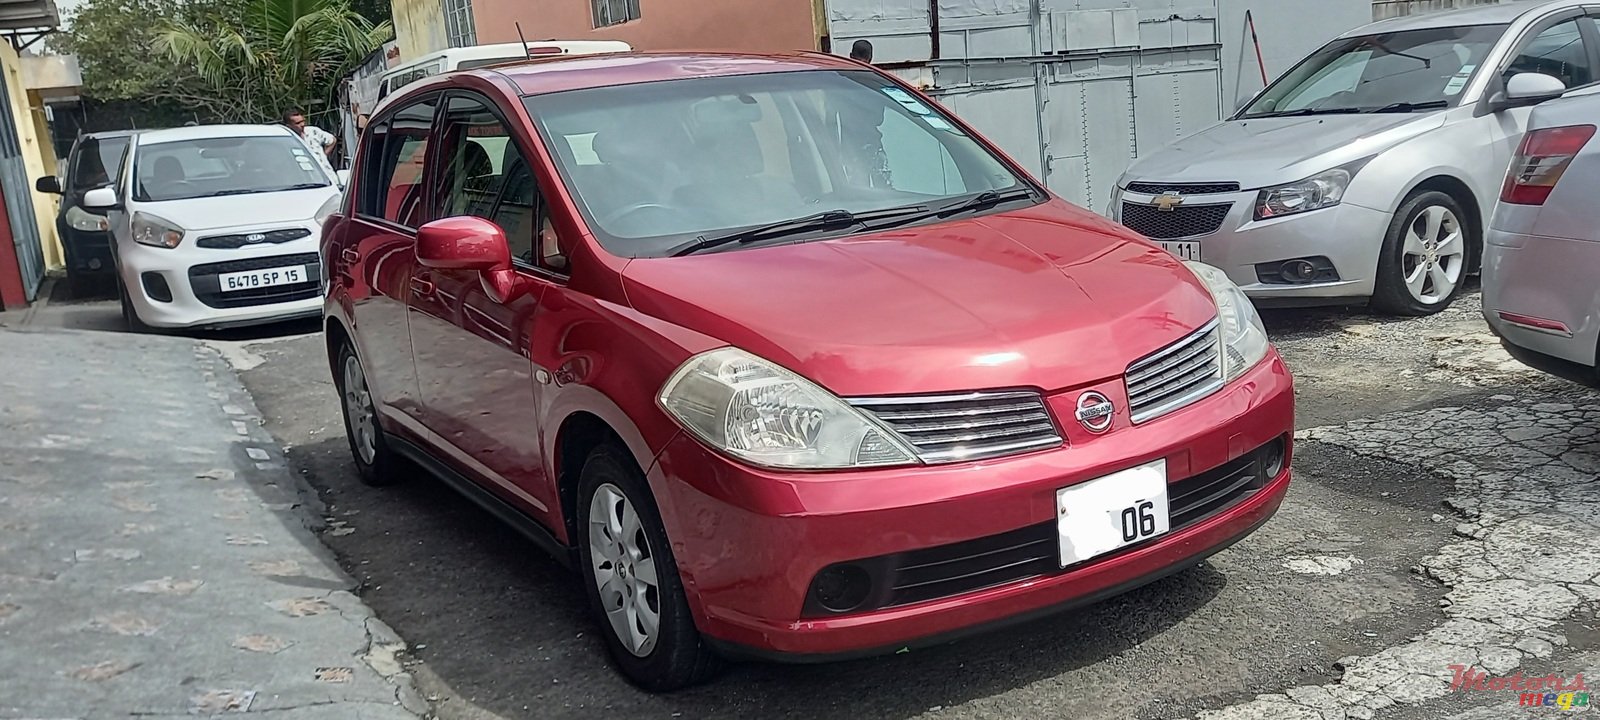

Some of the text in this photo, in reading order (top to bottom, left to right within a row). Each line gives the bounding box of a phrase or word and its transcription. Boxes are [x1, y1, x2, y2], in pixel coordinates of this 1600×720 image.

[1178, 243, 1191, 260] 11
[228, 270, 298, 289] 6478 SP 15
[1079, 404, 1111, 419] NISSAN
[1121, 501, 1155, 543] 06
